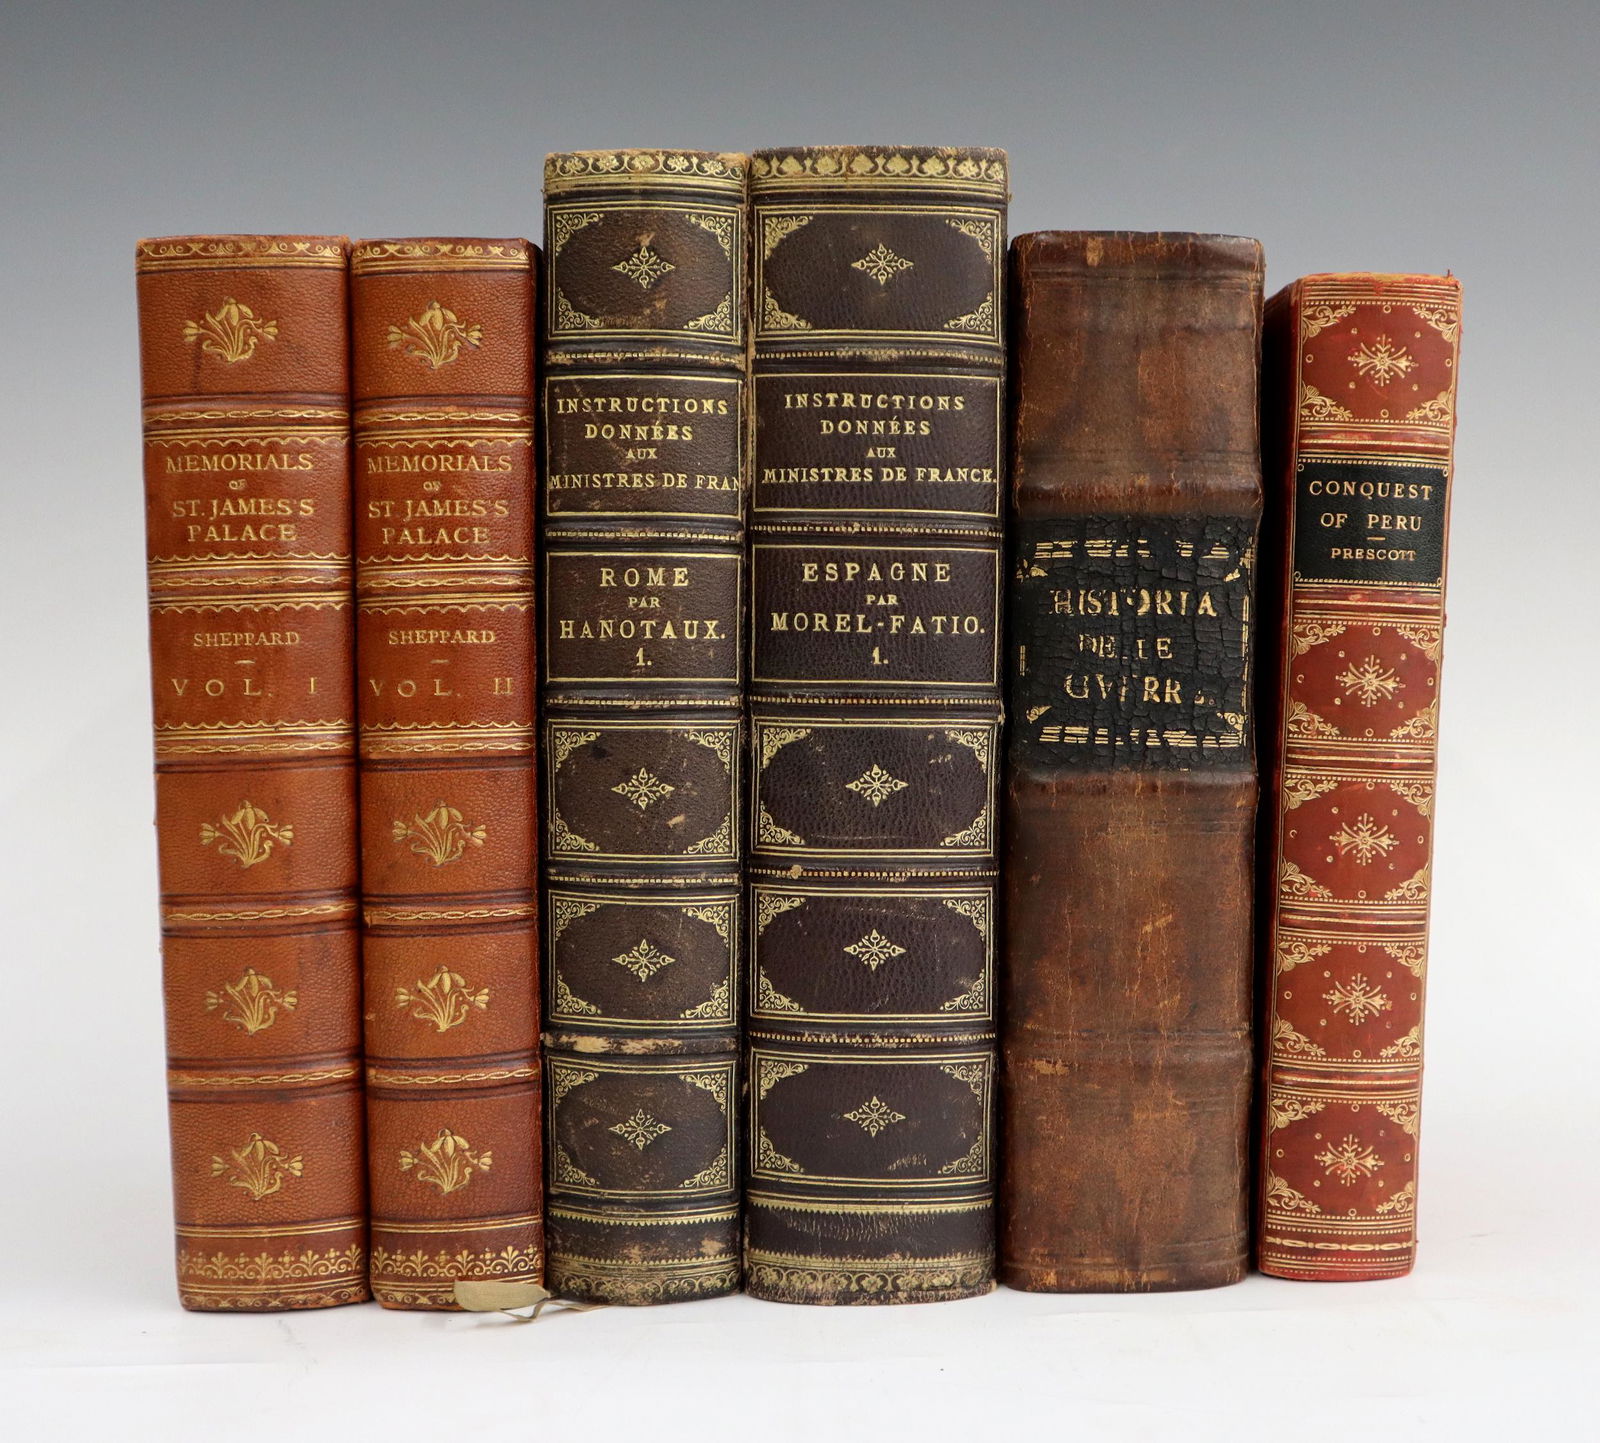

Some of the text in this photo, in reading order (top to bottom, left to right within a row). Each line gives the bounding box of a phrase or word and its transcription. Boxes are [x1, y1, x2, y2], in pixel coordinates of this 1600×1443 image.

[557, 398, 728, 416] INSTRUCTIONS
[784, 393, 965, 411] INSTRUCTIONS
[584, 420, 693, 441] DONNÉES
[821, 415, 931, 436] DONNÉES
[626, 448, 657, 459] AUX
[866, 447, 896, 458] AUX
[165, 453, 313, 473] MEMORIALS
[367, 455, 513, 473] MEMORIALS
[228, 478, 247, 490] OF
[550, 473, 655, 490] MINISTRES
[662, 473, 686, 488] DE
[762, 468, 998, 483] MINISTRES DE FRANCE.
[423, 480, 441, 492] OF
[1309, 481, 1433, 500] CONQUEST
[1321, 513, 1422, 532] OF PERU
[187, 524, 297, 543] PALACE
[382, 527, 490, 545] PALACE
[1331, 548, 1416, 561] PRESCOTT
[600, 567, 690, 587] ROME
[802, 563, 951, 582] ESPAGNE
[628, 596, 660, 608] PAR
[866, 594, 898, 605] PAR
[559, 620, 726, 641] HANOTAUX.
[771, 612, 986, 635] MOREL-FATIO.
[193, 632, 300, 647] SHEPPARD
[389, 630, 496, 645] SHEPPARD
[492, 677, 513, 695] II
